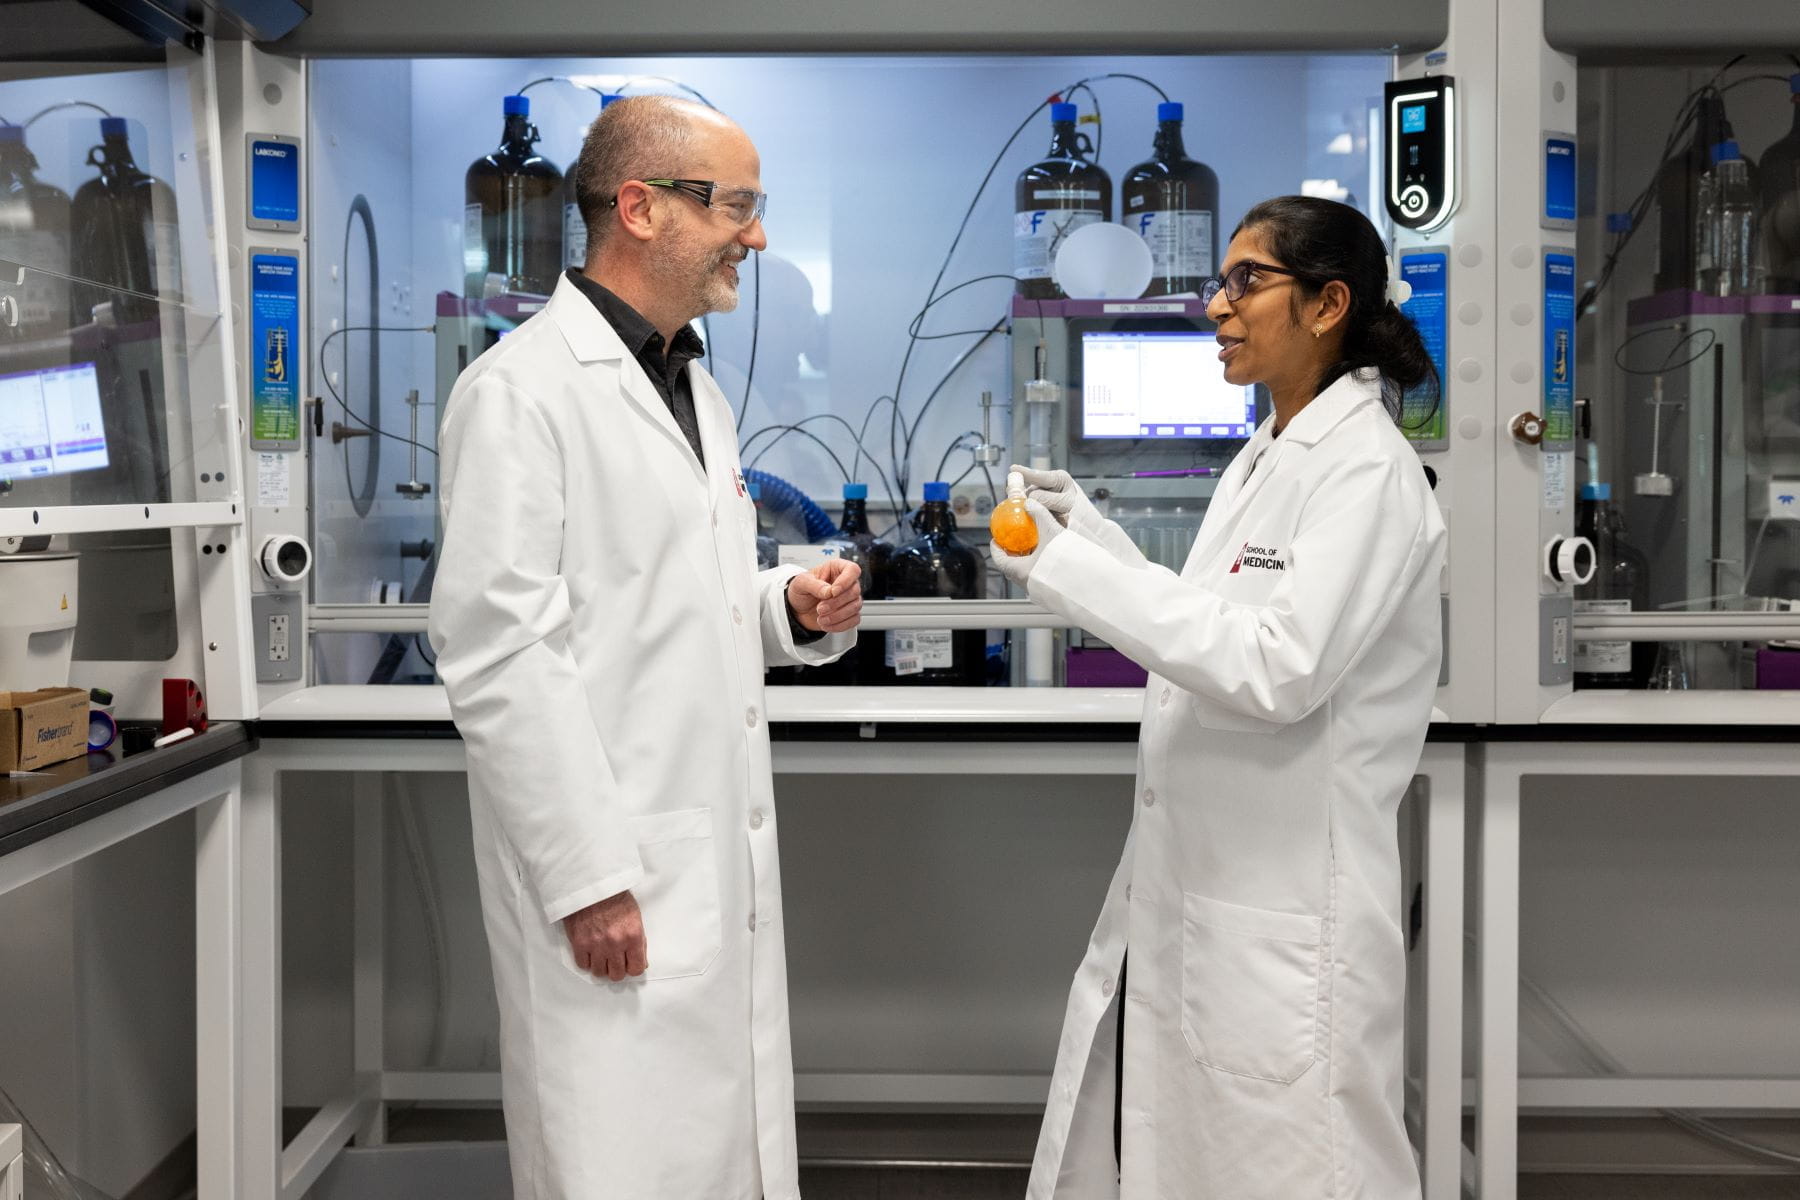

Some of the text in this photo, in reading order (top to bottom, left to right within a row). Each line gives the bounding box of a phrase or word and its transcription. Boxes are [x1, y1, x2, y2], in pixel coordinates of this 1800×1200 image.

[1031, 211, 1047, 235] F
[1139, 213, 1155, 236] F
[1246, 546, 1278, 556] SCHOOL OF
[1243, 556, 1286, 571] MEDICIN
